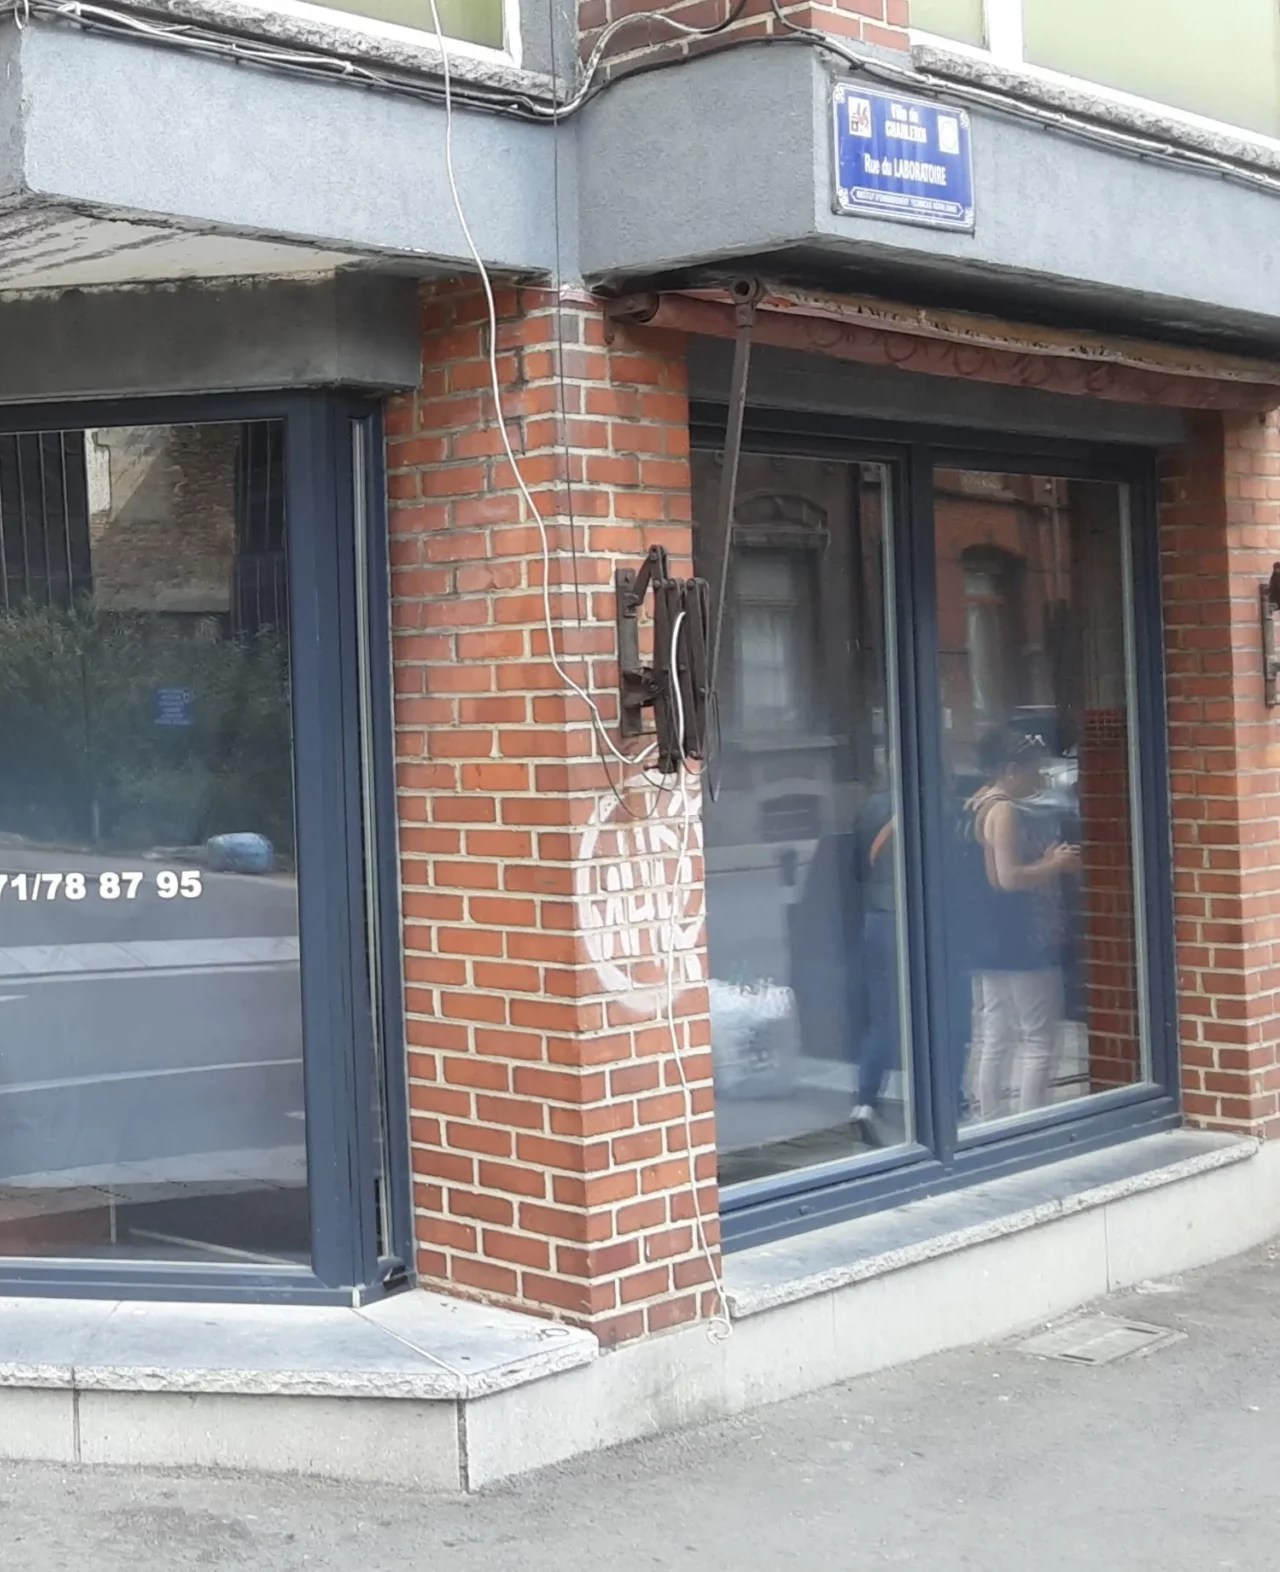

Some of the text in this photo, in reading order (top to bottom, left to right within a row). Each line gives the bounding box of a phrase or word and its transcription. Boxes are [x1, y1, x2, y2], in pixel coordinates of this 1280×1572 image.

[864, 153, 947, 186] Rue du LABORATOIRE
[99, 871, 144, 900] 87
[156, 870, 203, 899] 95
